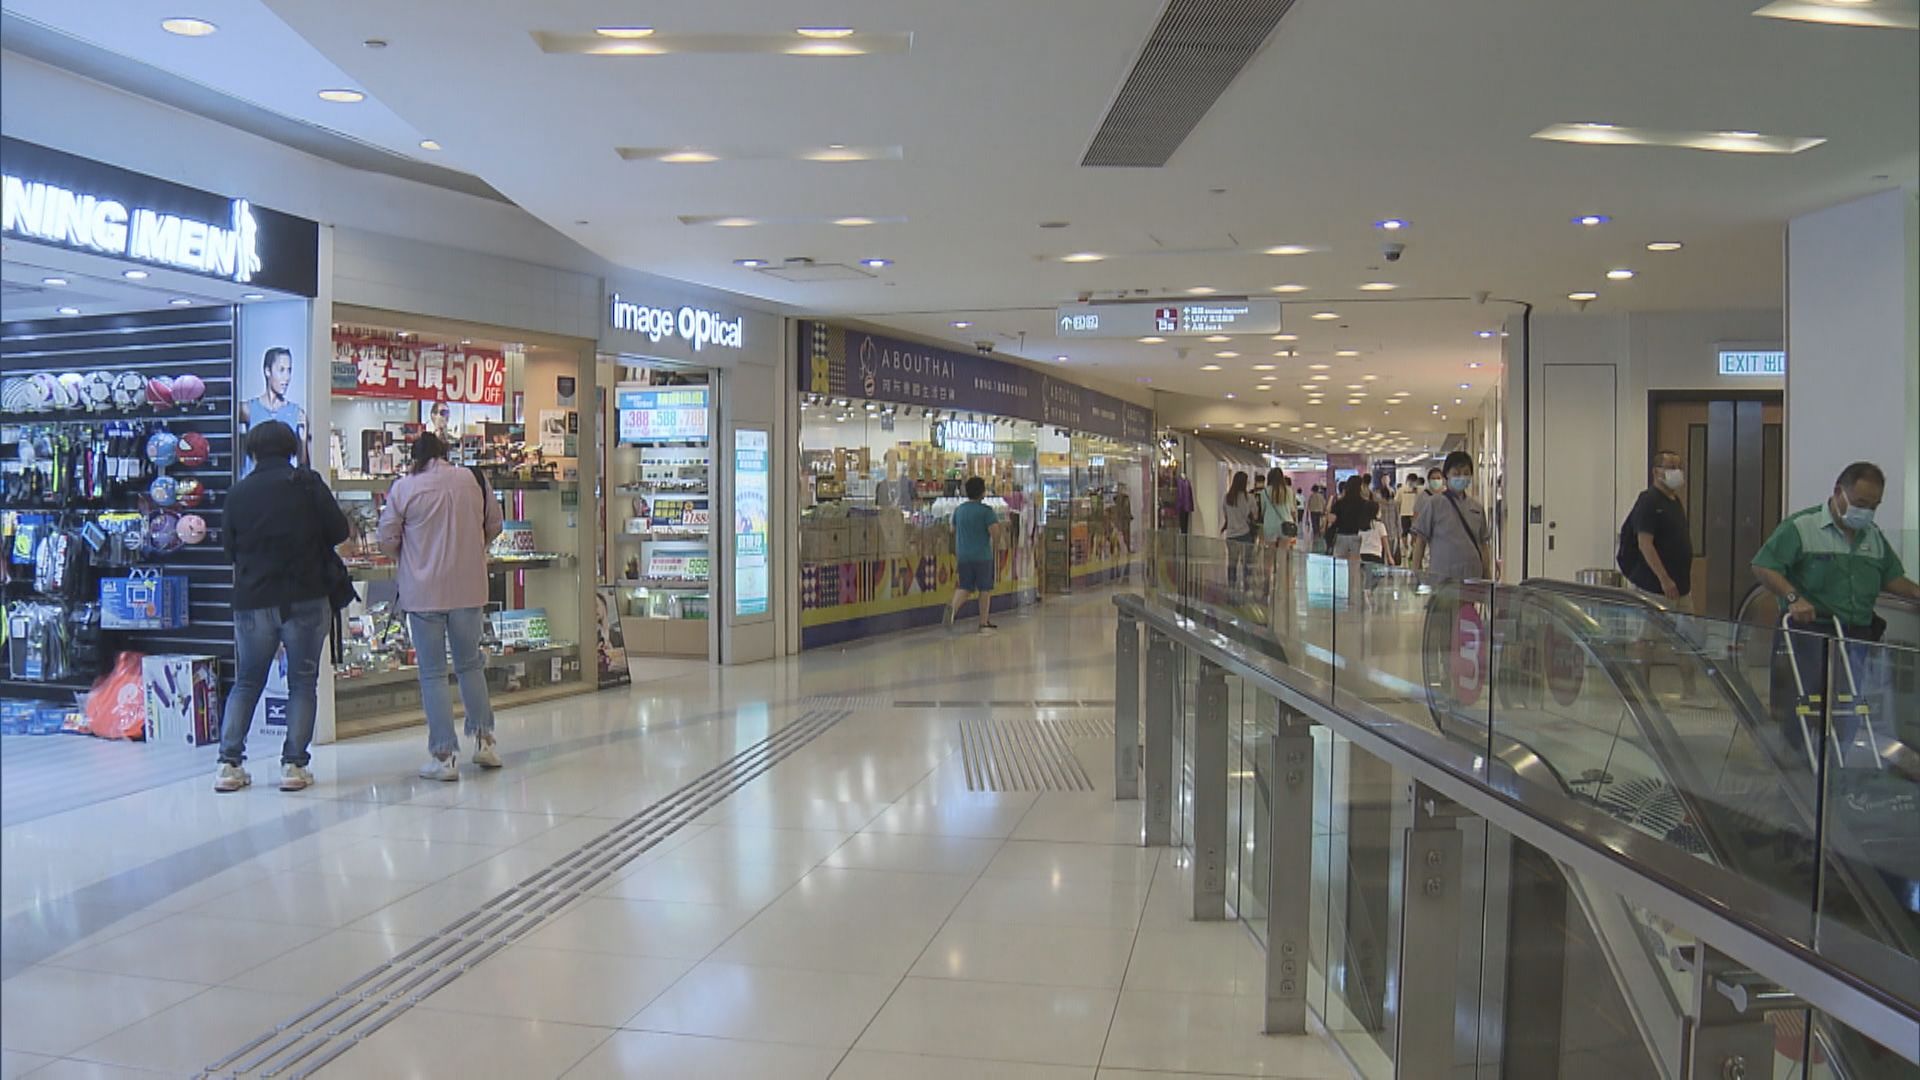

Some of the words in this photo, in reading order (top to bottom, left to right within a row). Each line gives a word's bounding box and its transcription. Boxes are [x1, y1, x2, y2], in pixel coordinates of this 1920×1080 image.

[130, 208, 238, 276] MEN
[613, 293, 673, 342] image
[881, 349, 955, 379] ABOUTHAI
[1726, 355, 1760, 372] EXIT
[485, 387, 501, 402] OFF
[945, 421, 993, 440] ABOUTHAI
